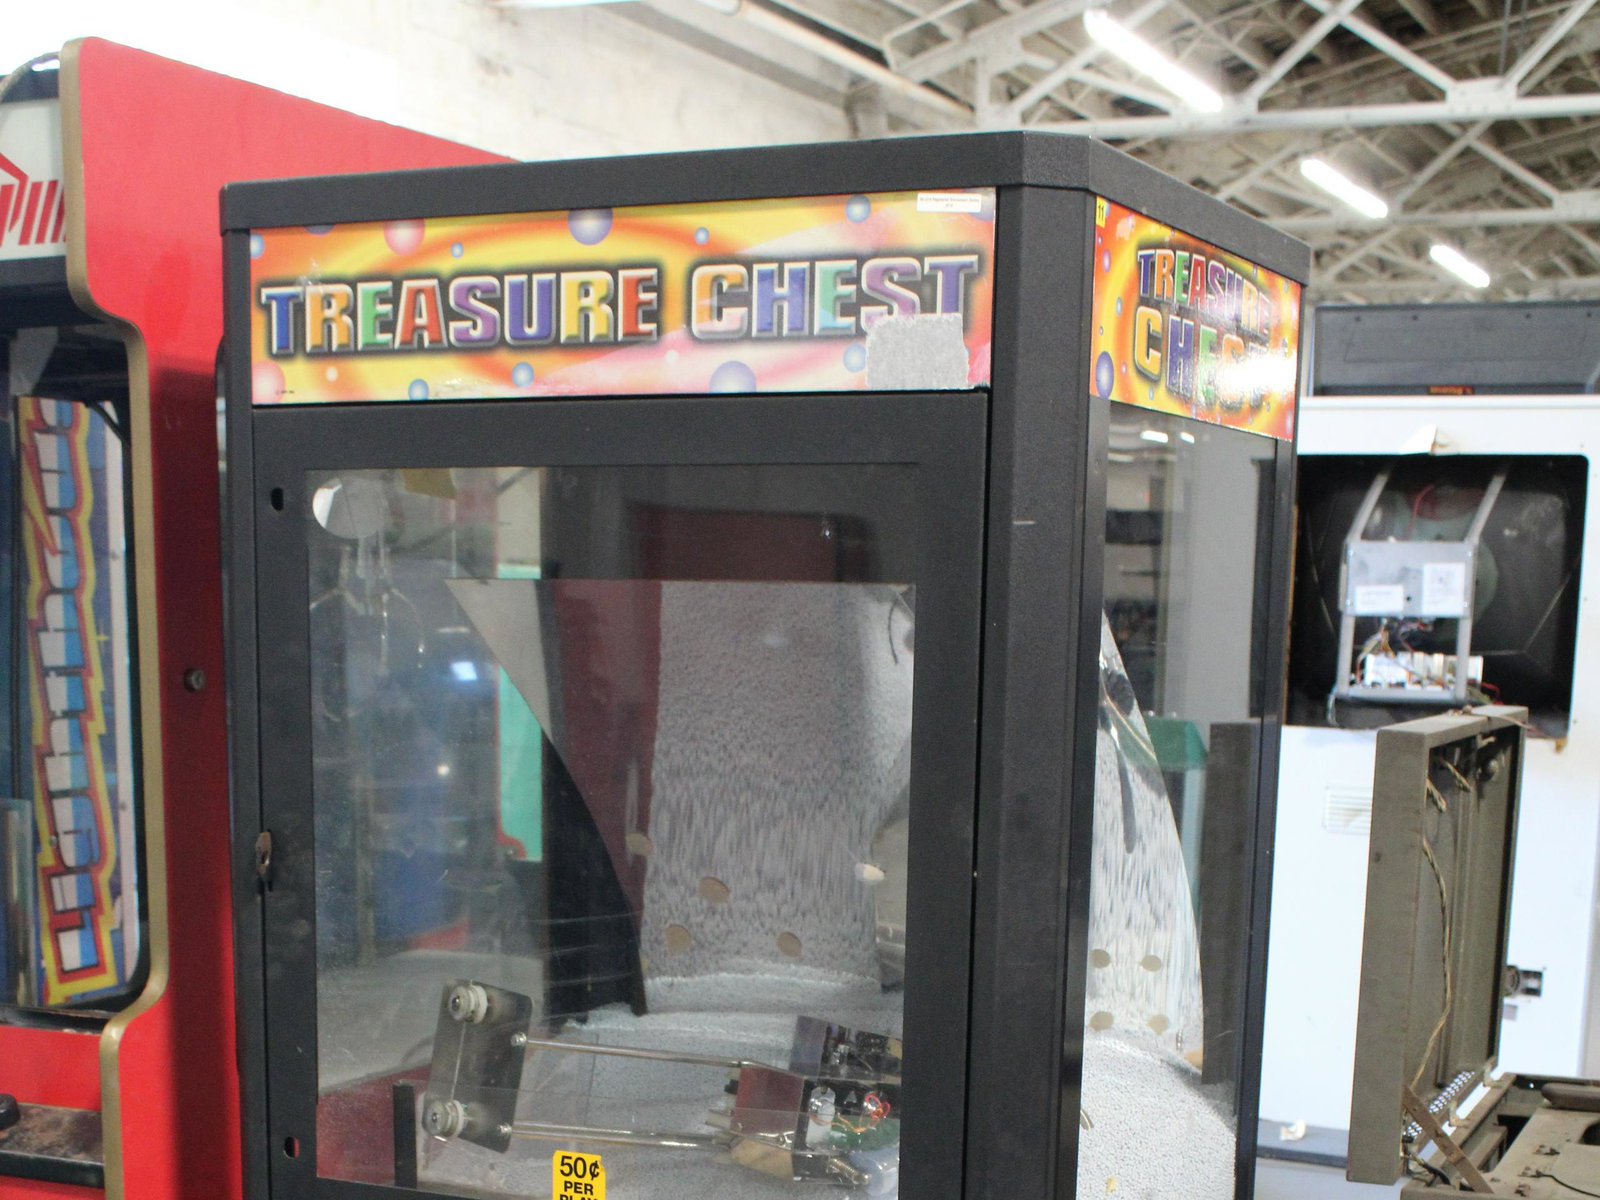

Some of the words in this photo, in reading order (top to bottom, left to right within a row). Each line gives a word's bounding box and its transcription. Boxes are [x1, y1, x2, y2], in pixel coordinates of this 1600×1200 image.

[260, 267, 661, 354] TREASURE
[690, 254, 980, 339] CHEST
[1137, 249, 1272, 336] TREASURE
[559, 1154, 600, 1181] 50¢
[563, 1180, 594, 1196] PER
